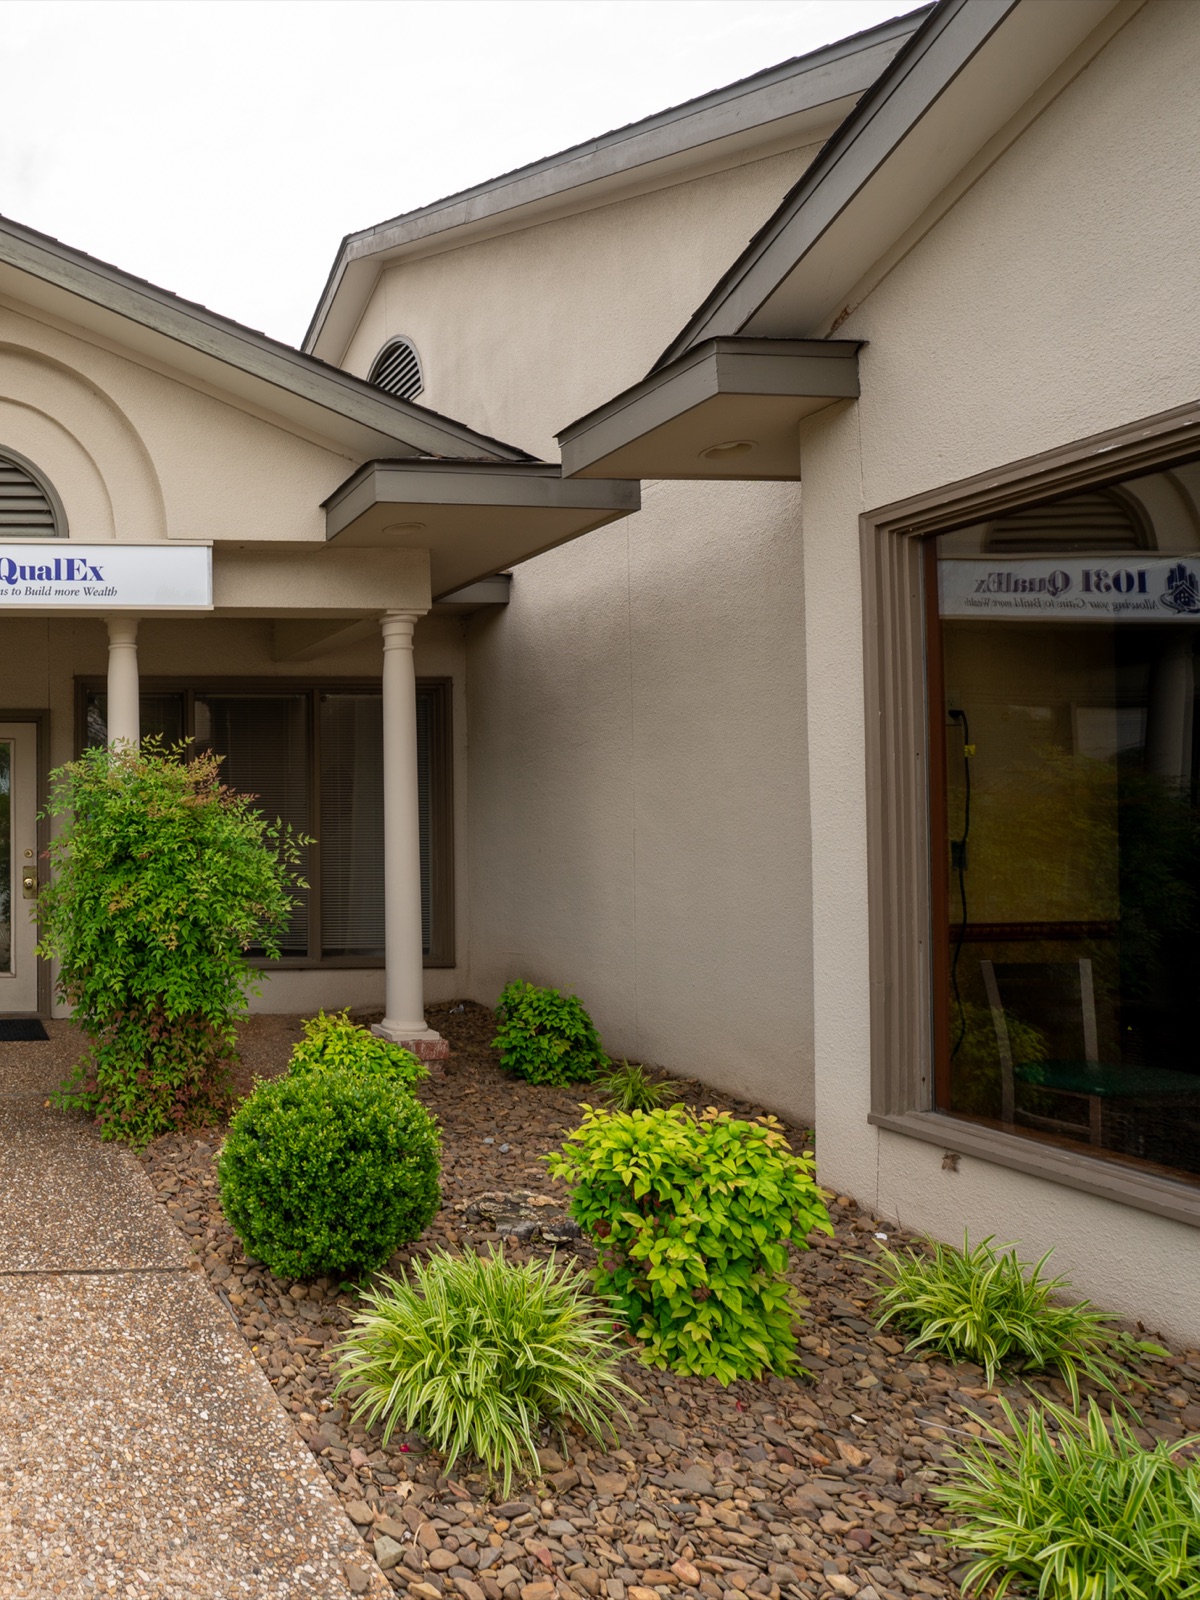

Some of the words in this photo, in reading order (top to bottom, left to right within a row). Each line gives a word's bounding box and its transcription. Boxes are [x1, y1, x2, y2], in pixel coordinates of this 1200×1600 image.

[11, 587, 22, 596] to
[24, 586, 52, 596] Build
[54, 589, 80, 597] more
[83, 586, 118, 597] Wealth
